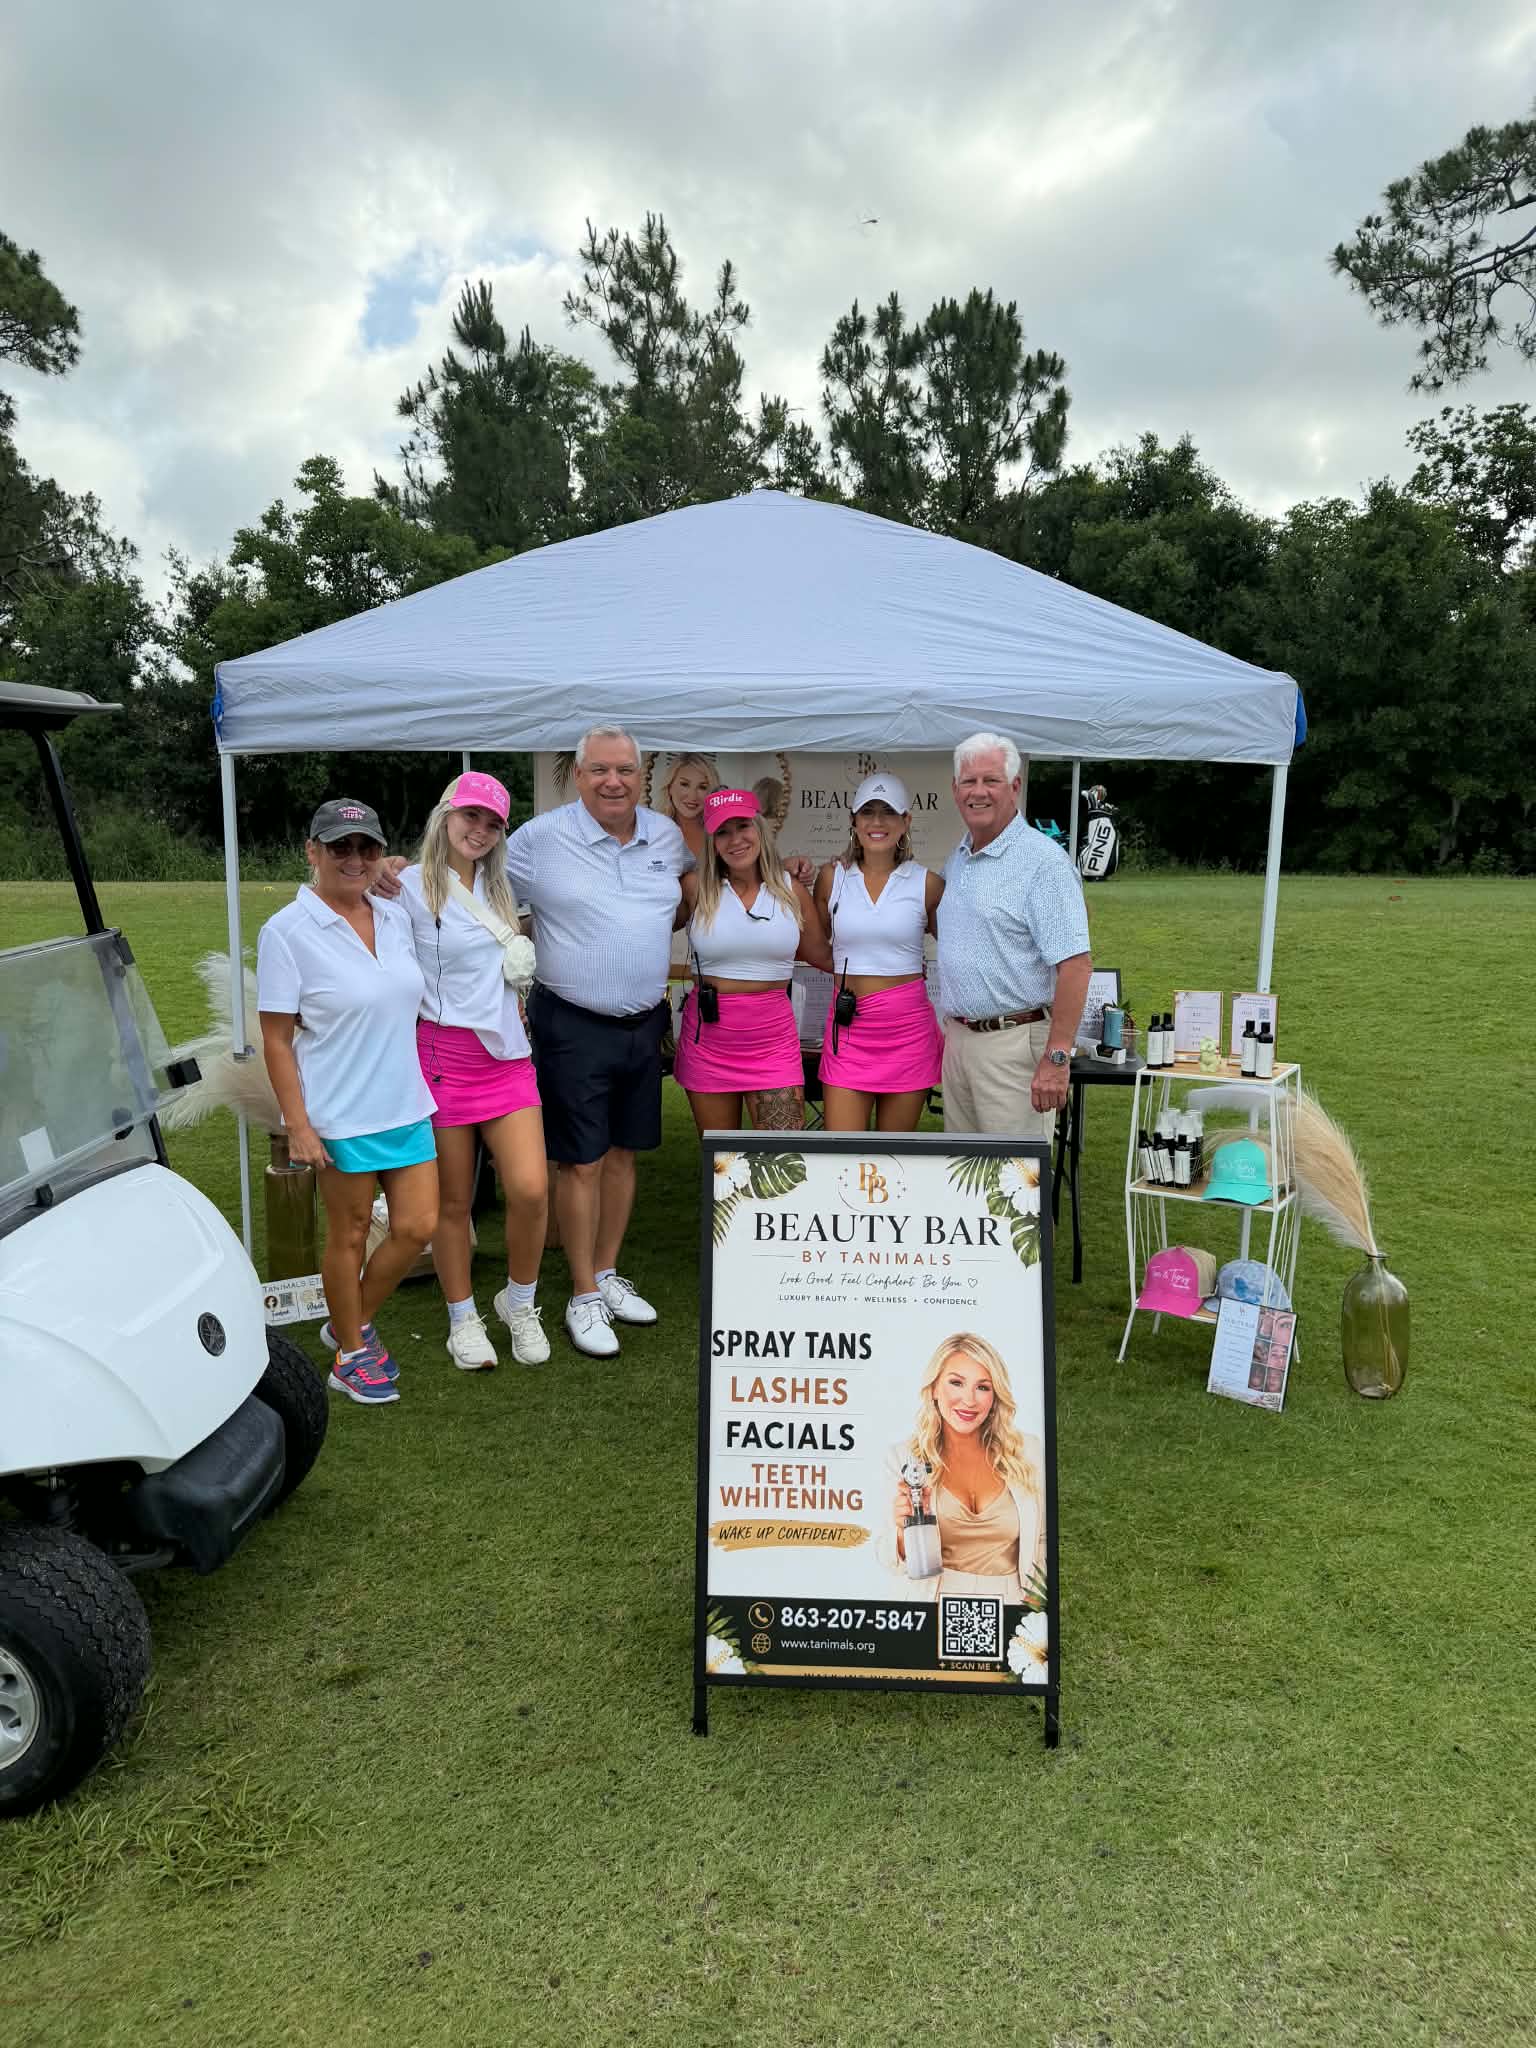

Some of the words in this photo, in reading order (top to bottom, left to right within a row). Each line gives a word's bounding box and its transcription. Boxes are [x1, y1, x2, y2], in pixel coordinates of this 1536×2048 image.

[709, 793, 744, 807] Birdie
[1088, 825, 1111, 872] PING
[754, 1212, 911, 1243] BEAUTY
[924, 1215, 1002, 1246] BAR
[802, 1250, 827, 1263] BY
[840, 1251, 951, 1266] TANIMALS
[779, 1272, 802, 1285] Look
[922, 1275, 937, 1288] Be
[864, 1296, 907, 1304] WELLNESS
[923, 1297, 977, 1306] CONFIDENCE
[712, 1330, 796, 1358] SPRAY
[805, 1332, 872, 1360] TANS
[731, 1376, 848, 1405] LASHES
[726, 1421, 855, 1451] FACIALS
[752, 1463, 827, 1485] TEETH
[720, 1486, 863, 1511] WHITENING
[719, 1526, 752, 1540] WAKE
[756, 1526, 775, 1539] UP
[778, 1526, 847, 1541] CONFIDENT.
[781, 1607, 927, 1632] 863-207-5847
[781, 1639, 876, 1653] www.tanimals.org
[950, 1662, 975, 1670] SCAN
[977, 1663, 991, 1671] ME
